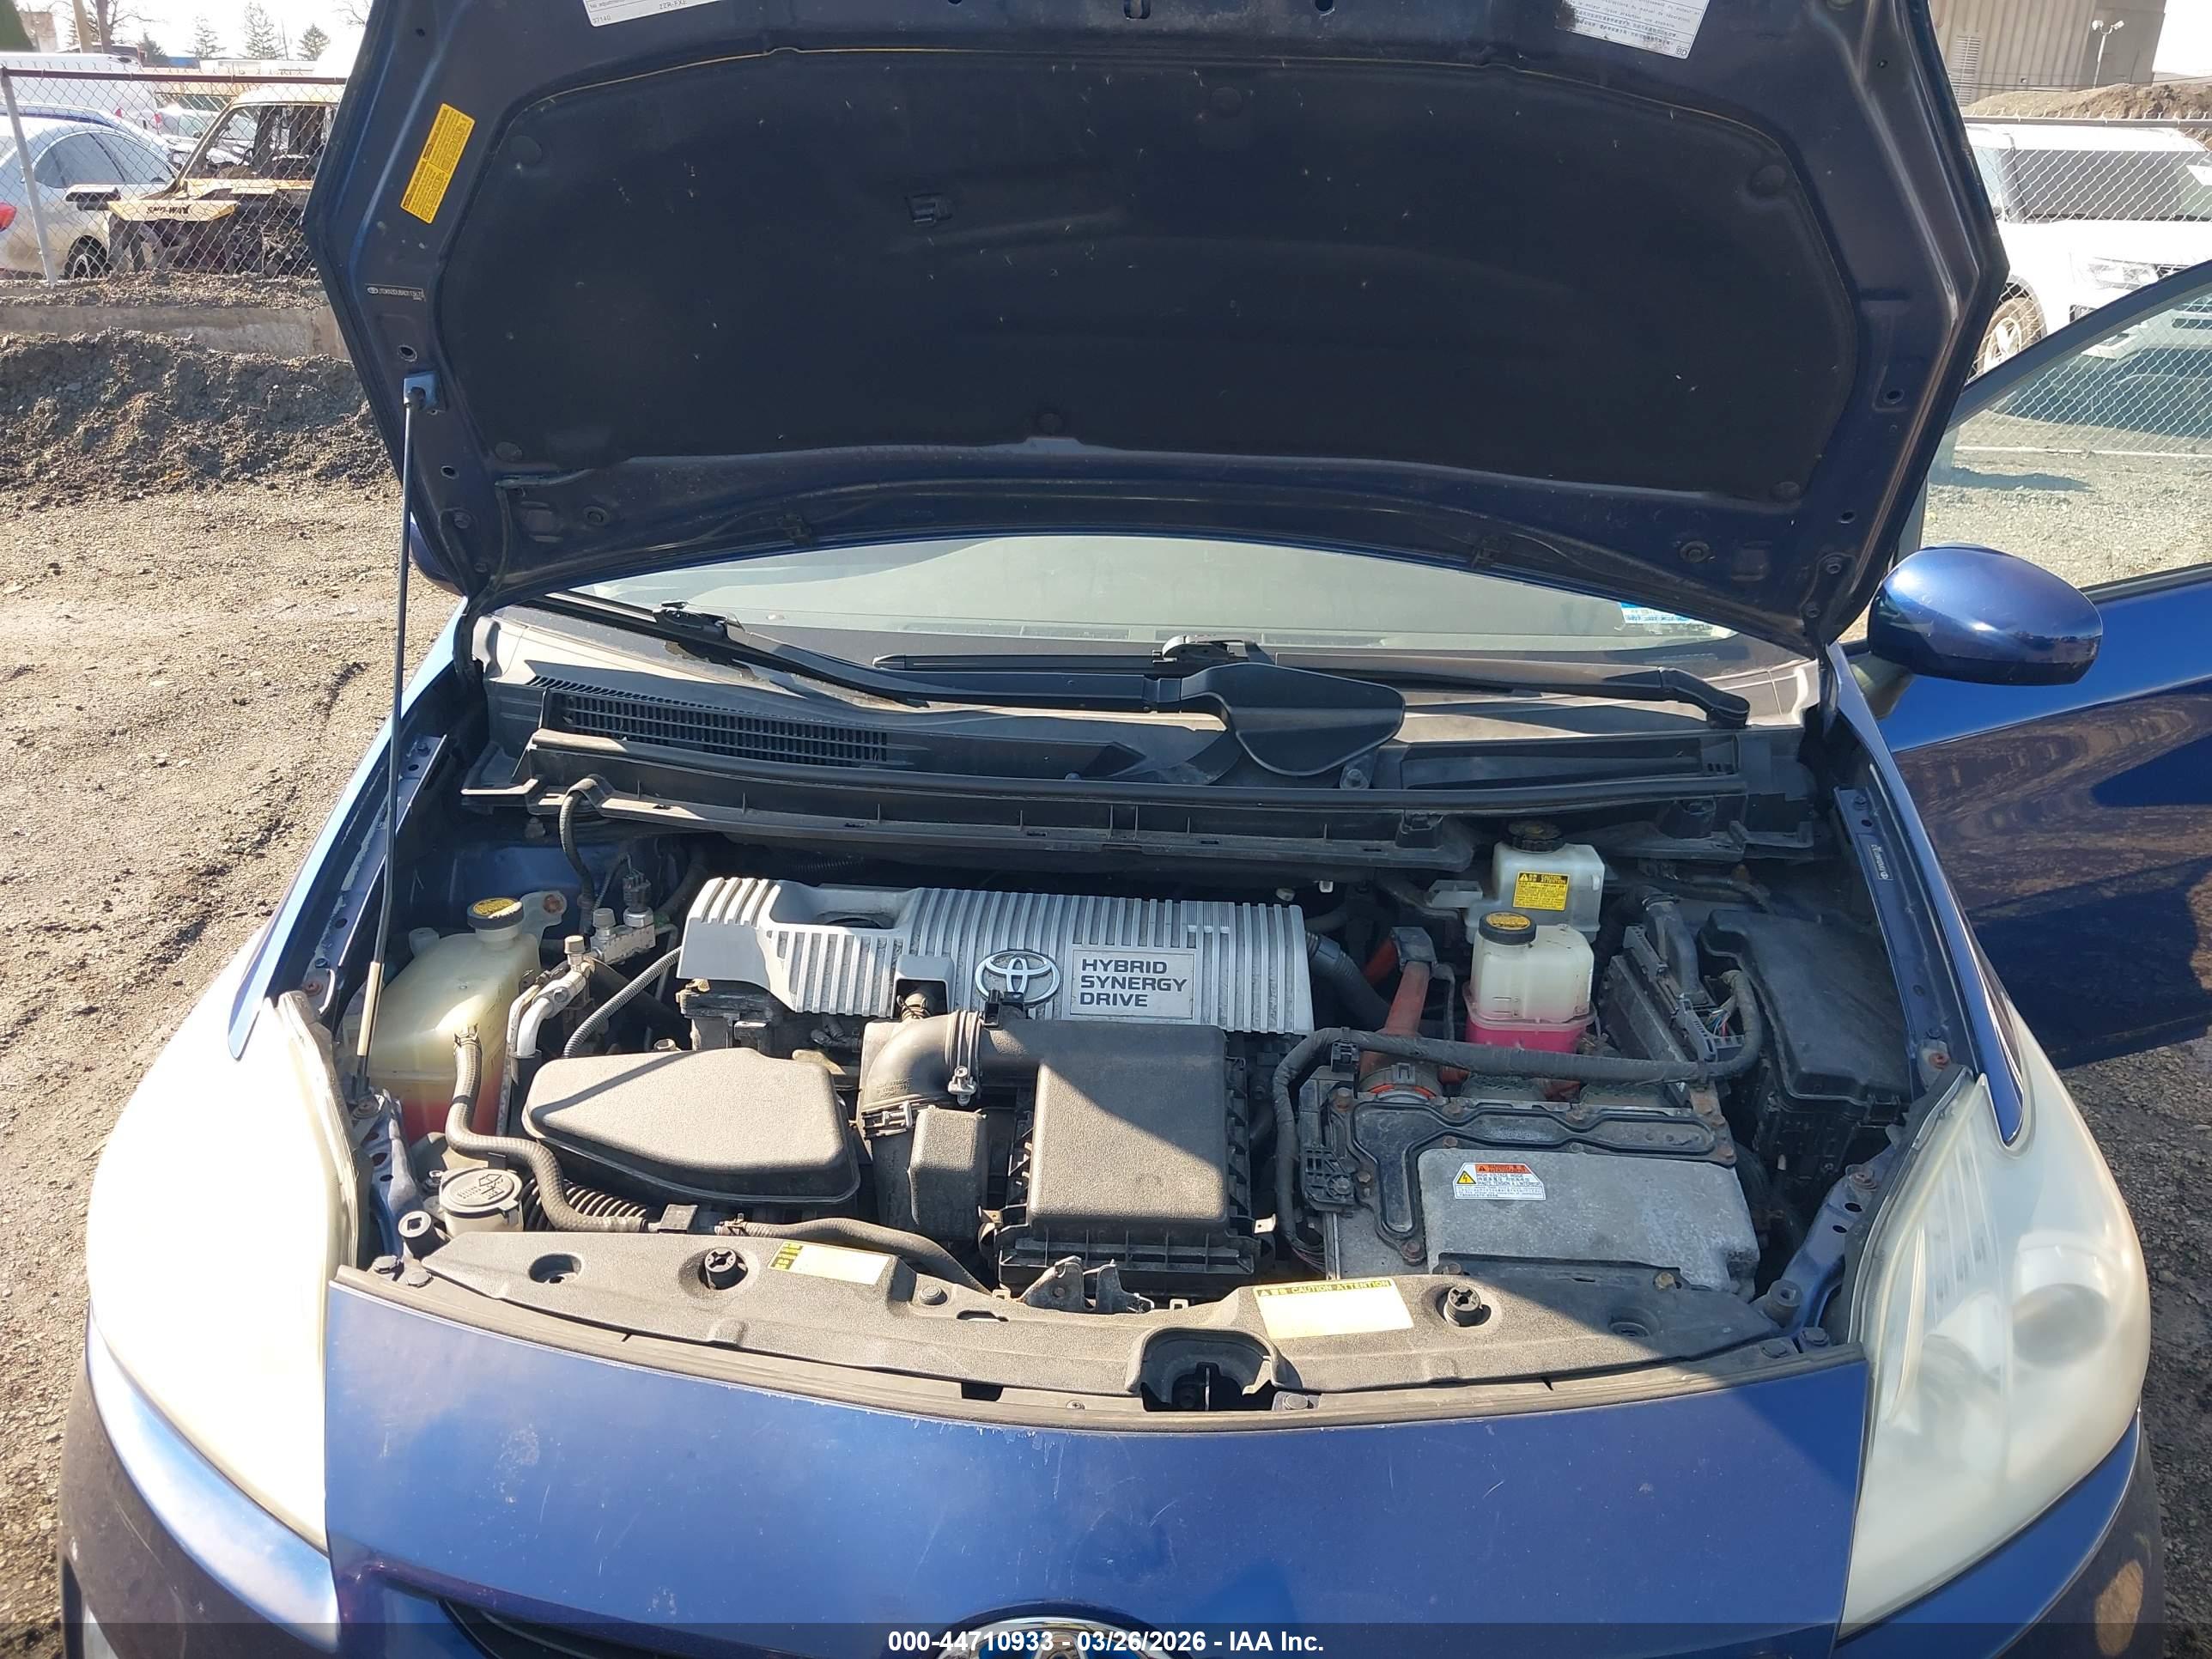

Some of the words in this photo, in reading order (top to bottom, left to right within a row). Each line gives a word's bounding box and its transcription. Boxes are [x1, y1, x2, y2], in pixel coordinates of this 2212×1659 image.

[1081, 959, 1168, 975] HYBRID
[1080, 975, 1188, 992] SYNERGY
[1079, 992, 1148, 1007] DRIVE
[1292, 1285, 1333, 1294] CAUTION
[1336, 1279, 1390, 1291] ATTENTION
